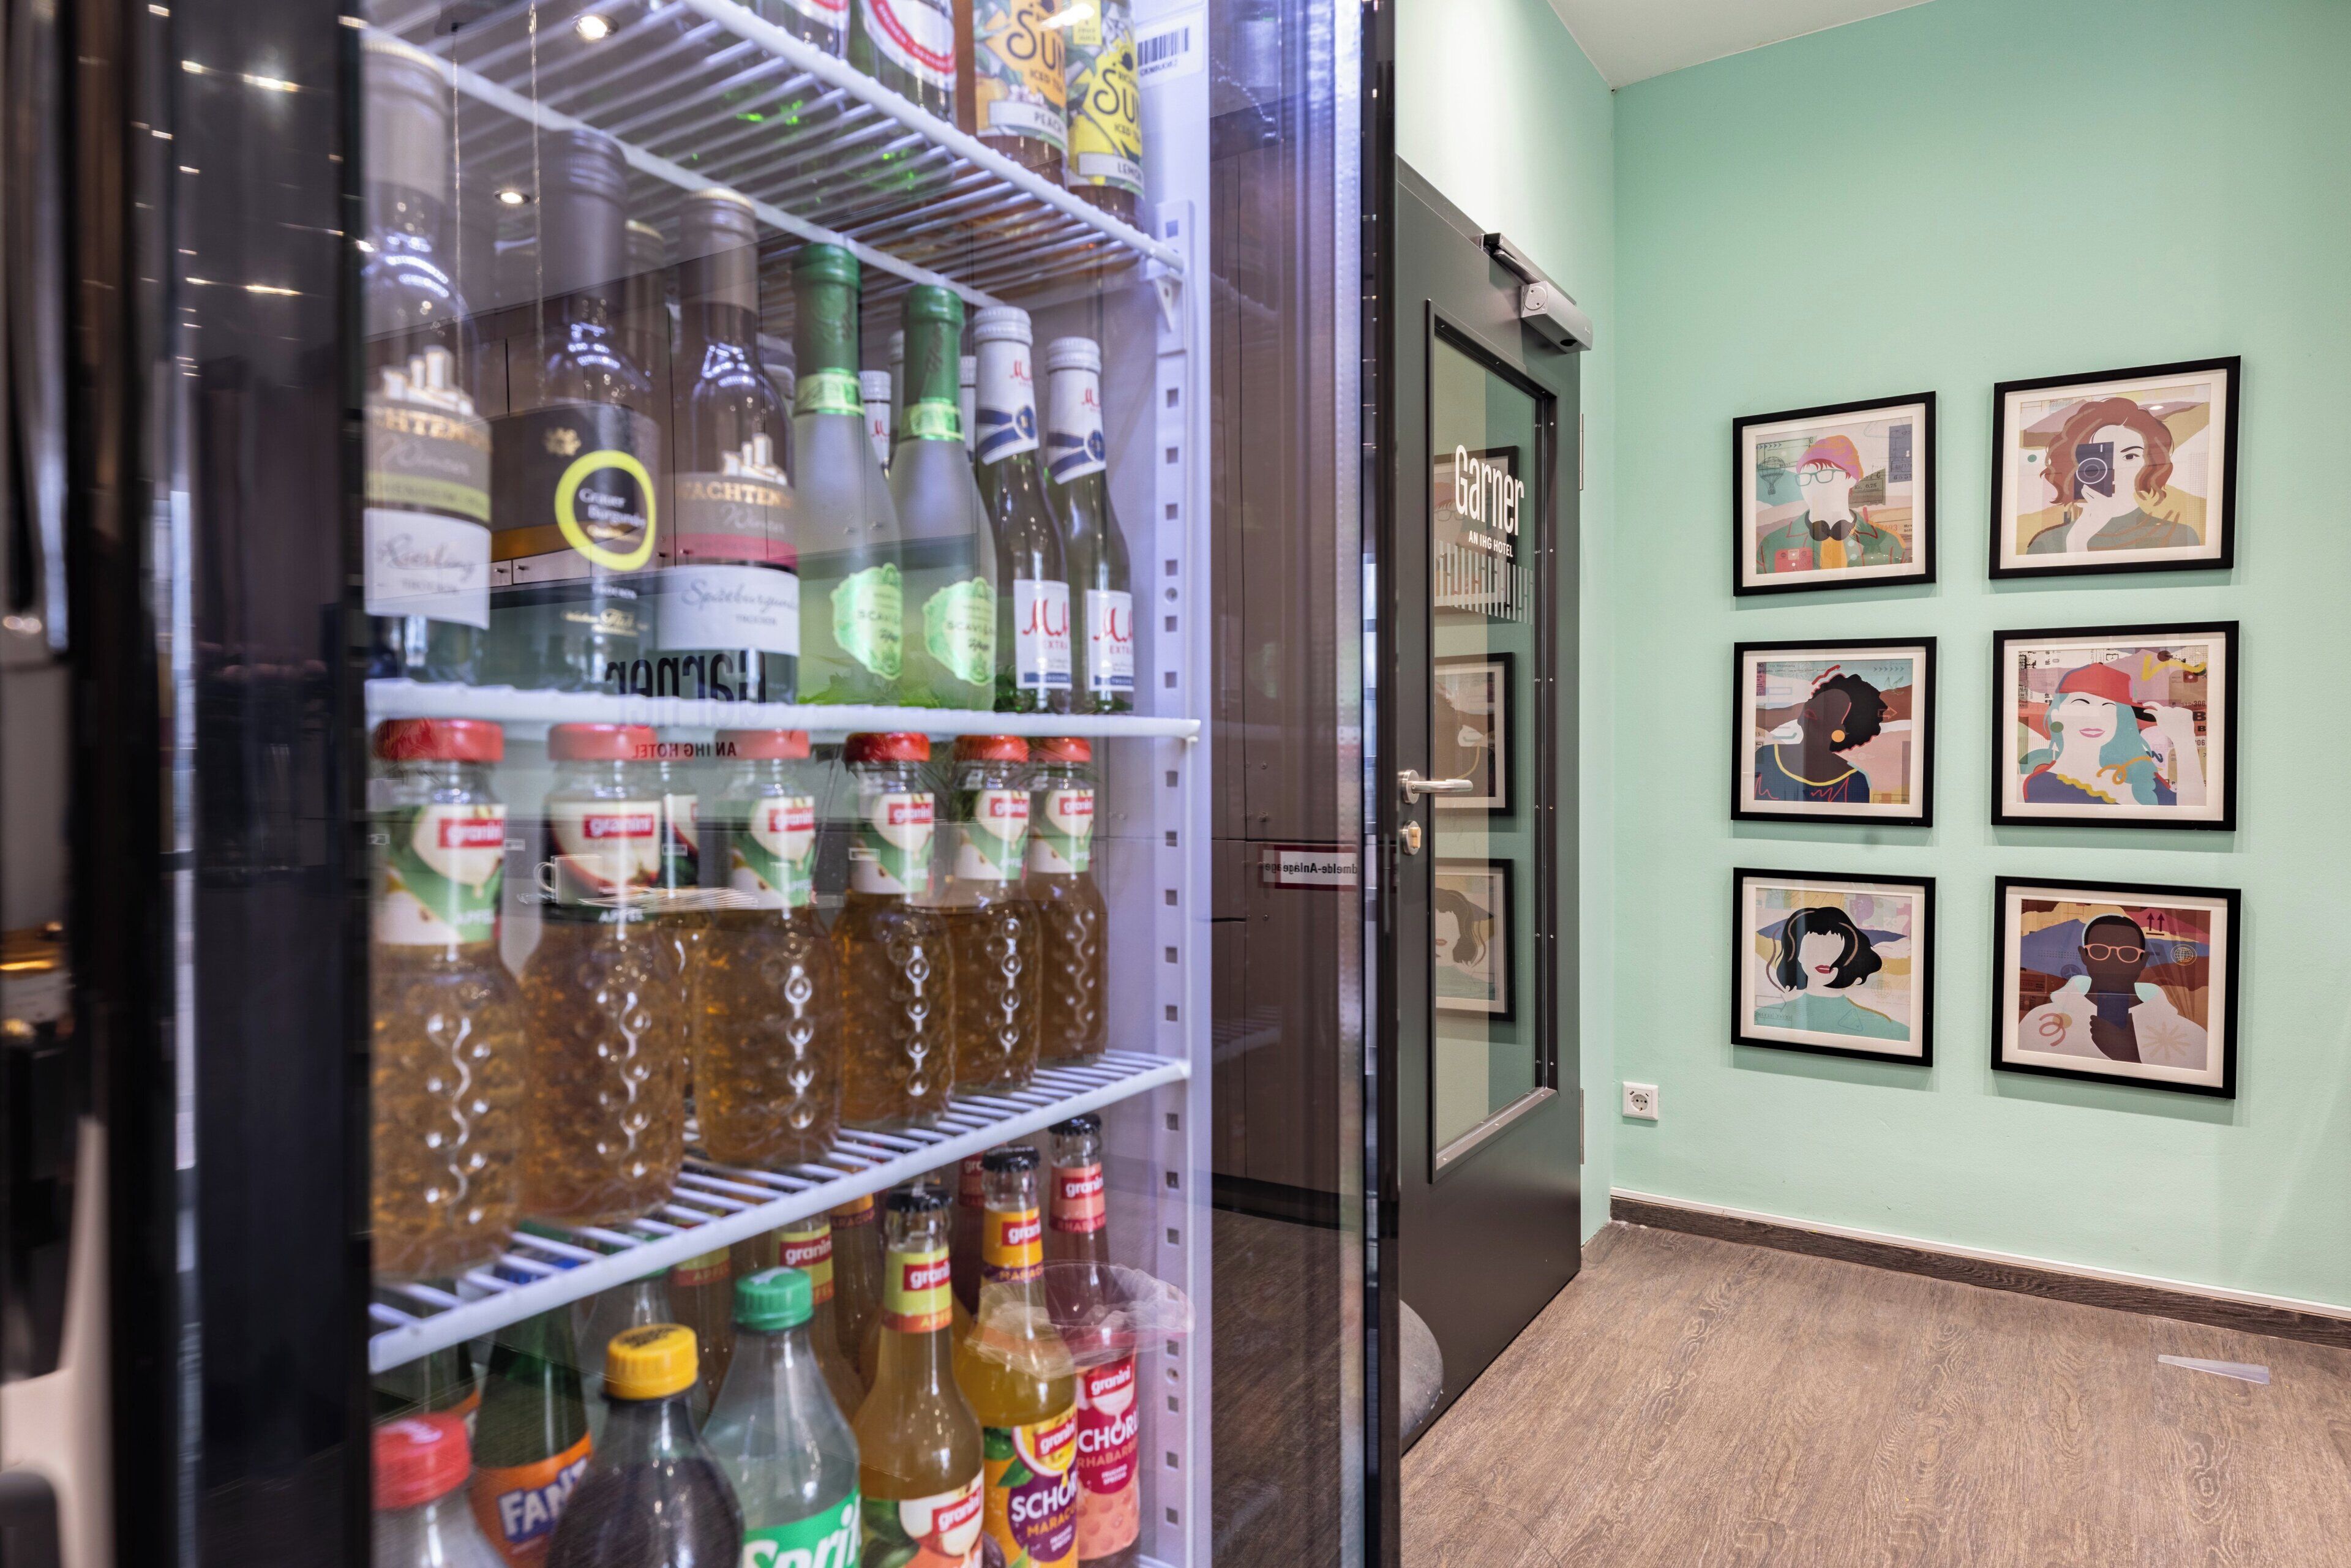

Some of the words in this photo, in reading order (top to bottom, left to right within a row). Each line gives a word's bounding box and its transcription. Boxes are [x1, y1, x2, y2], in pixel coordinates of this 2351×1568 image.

[1455, 445, 1524, 536] Garner
[1469, 531, 1479, 543] AN
[1479, 533, 1492, 550] IHG
[1493, 538, 1513, 558] HOTEL
[1090, 1365, 1131, 1396] granini
